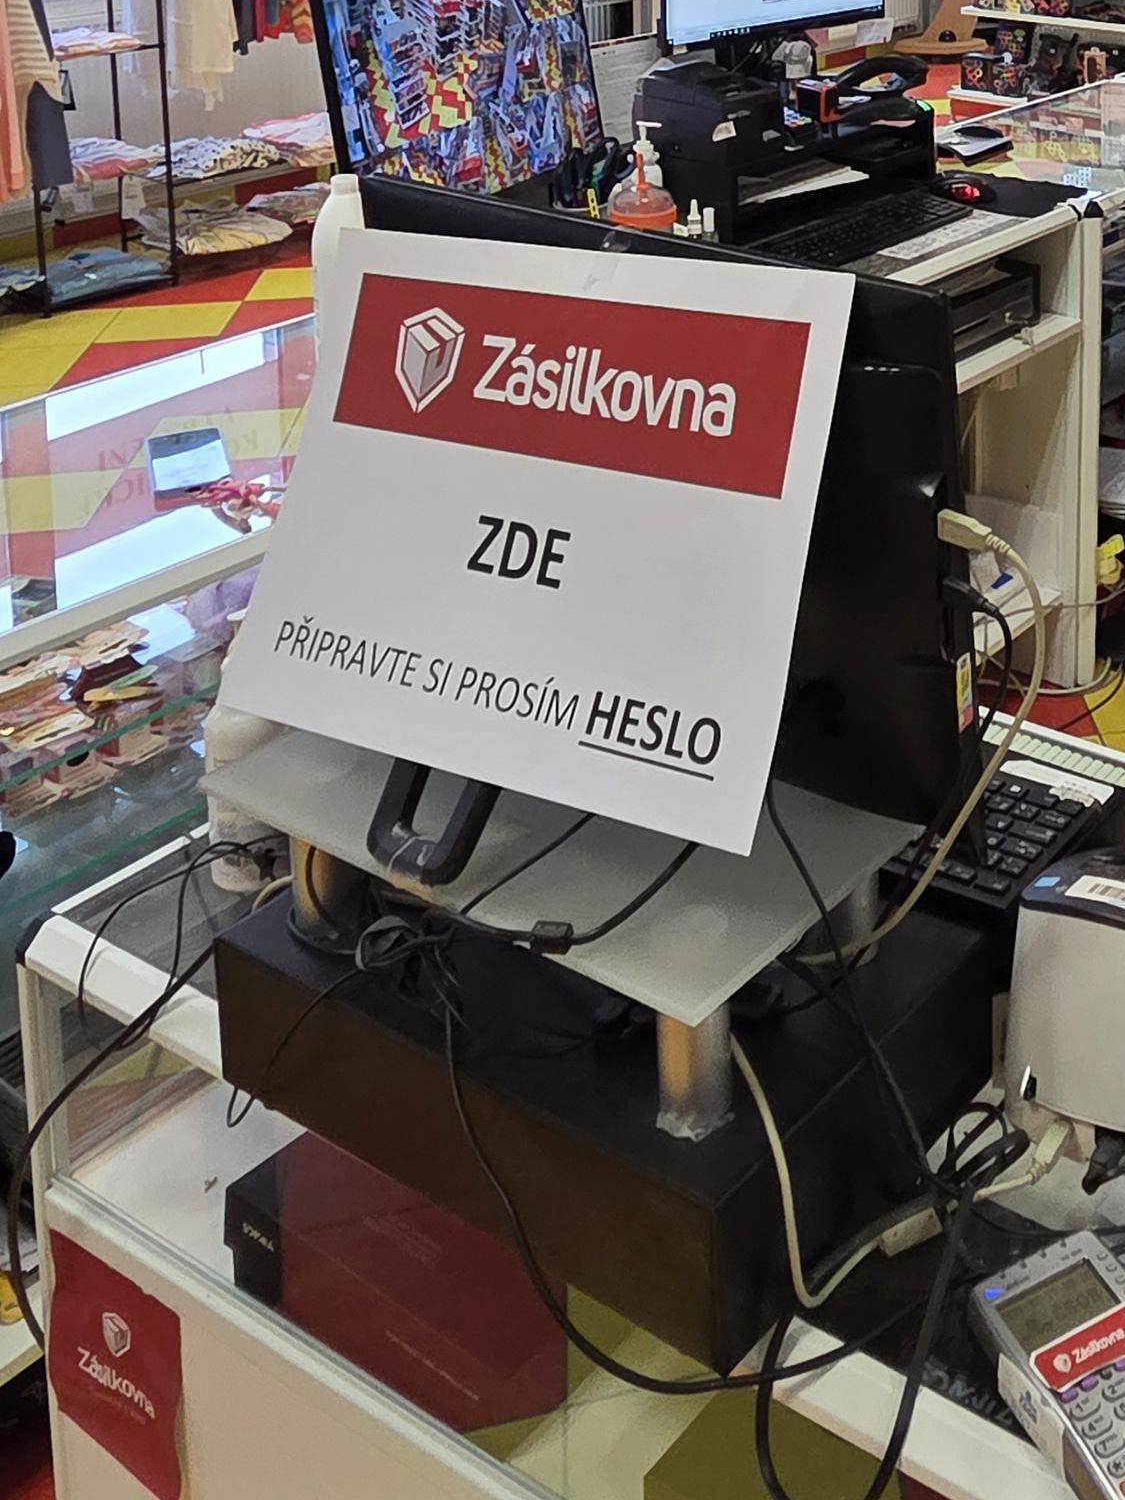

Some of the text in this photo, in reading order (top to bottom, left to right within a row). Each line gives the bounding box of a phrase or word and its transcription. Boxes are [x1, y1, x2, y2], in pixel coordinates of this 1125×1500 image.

[472, 333, 737, 438] Zásilkovna
[467, 514, 572, 590] ZDE
[274, 615, 723, 767] PŘIPRAVTE SI PROSÍM HESLO
